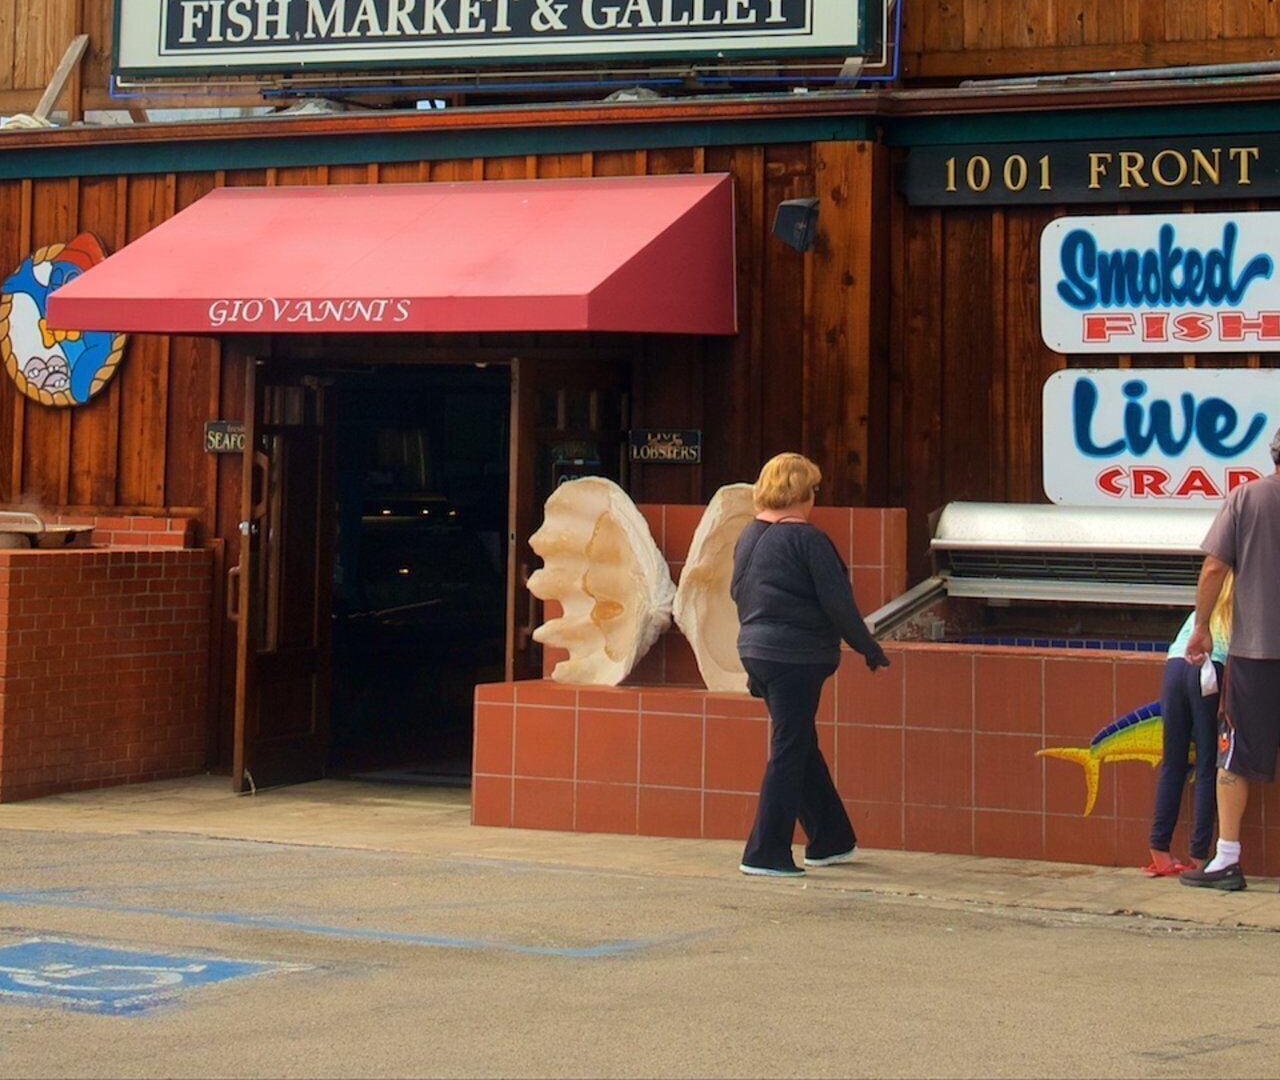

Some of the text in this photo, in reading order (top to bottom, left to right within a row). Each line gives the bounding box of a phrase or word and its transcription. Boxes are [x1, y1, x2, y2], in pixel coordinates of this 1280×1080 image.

[945, 154, 1052, 192] 1001
[1089, 146, 1259, 190] FRONT
[1057, 221, 1273, 310] Smoked
[209, 298, 410, 326] GIOVANNI'S
[1072, 377, 1267, 459] Live
[632, 446, 697, 459] LOBSTERS
